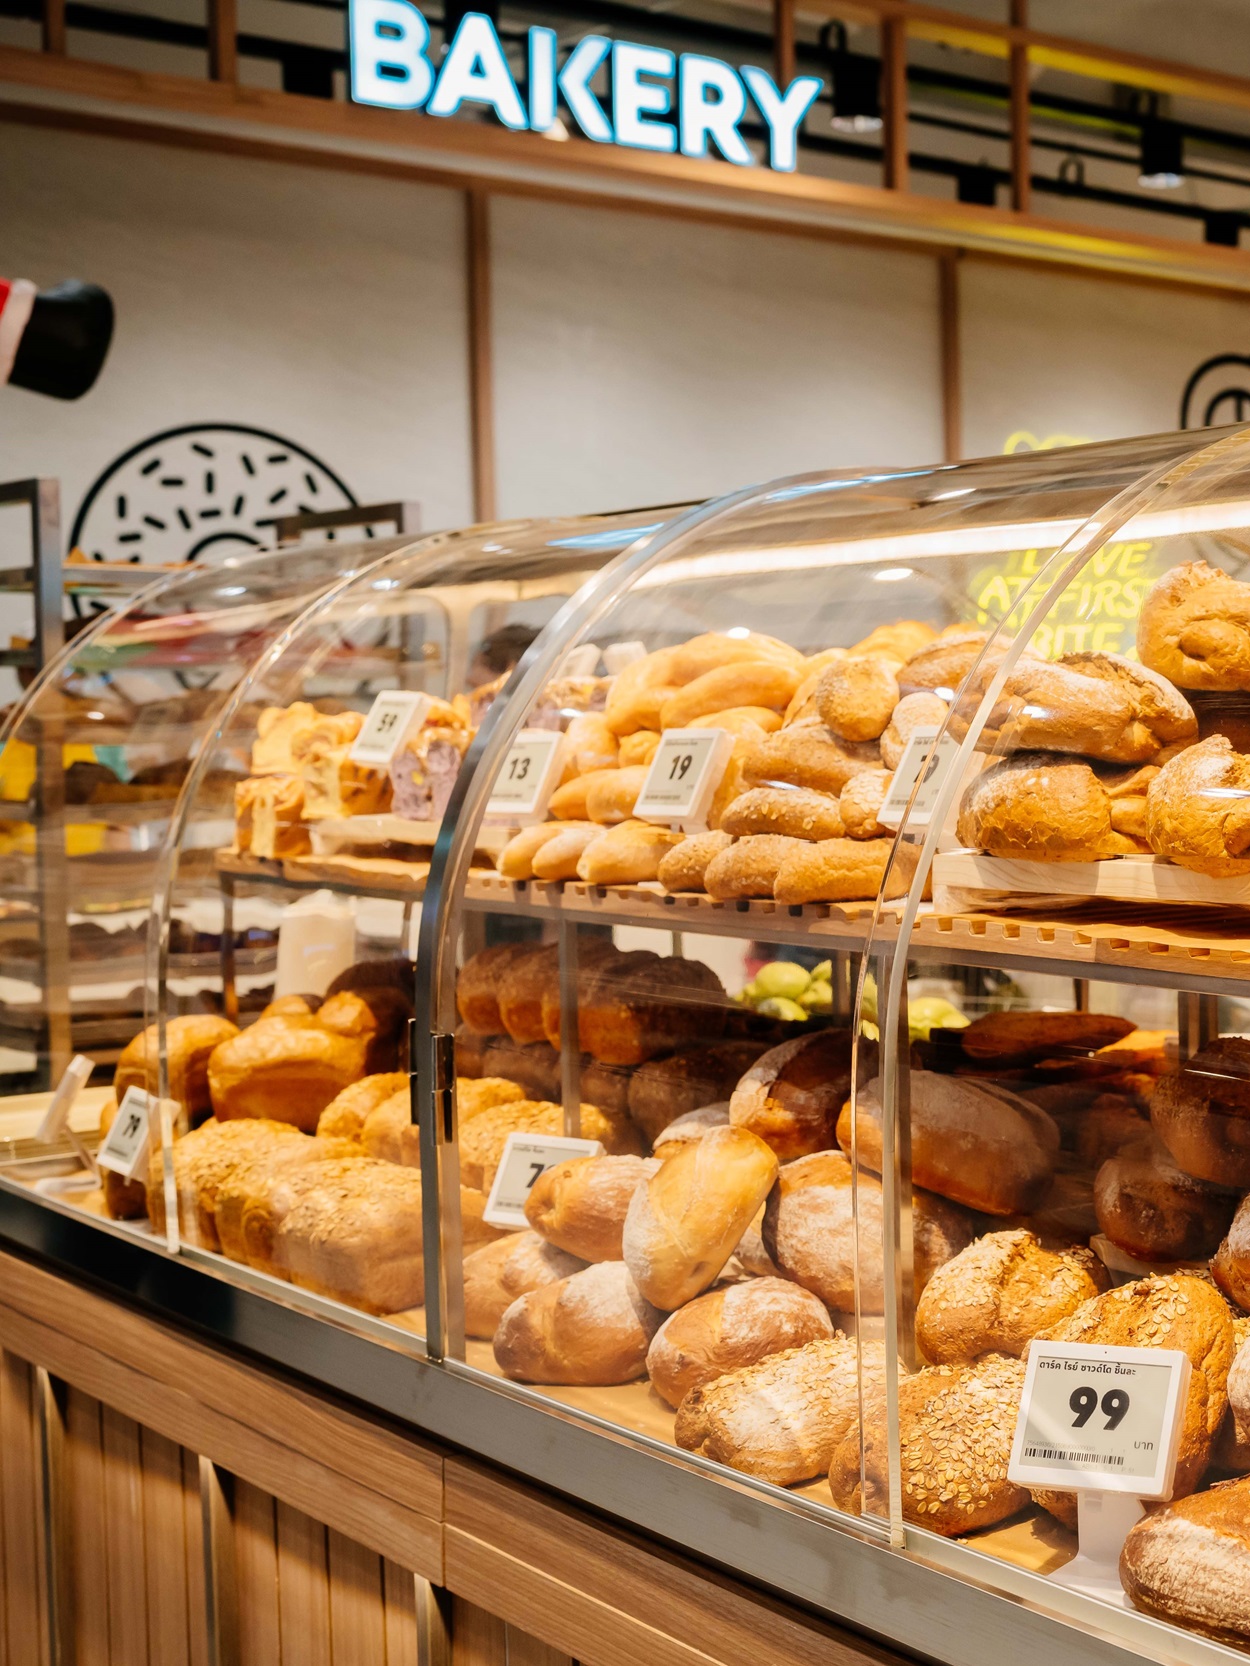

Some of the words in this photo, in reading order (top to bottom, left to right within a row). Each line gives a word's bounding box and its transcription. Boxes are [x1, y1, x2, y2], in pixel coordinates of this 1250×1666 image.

[349, 0, 823, 172] BAKERY
[1021, 541, 1153, 577] LVE
[376, 713, 398, 733] 59
[509, 757, 531, 780] 13
[669, 754, 692, 780] 19
[1069, 1386, 1130, 1430] 99
[1134, 1440, 1154, 1451] บาท
